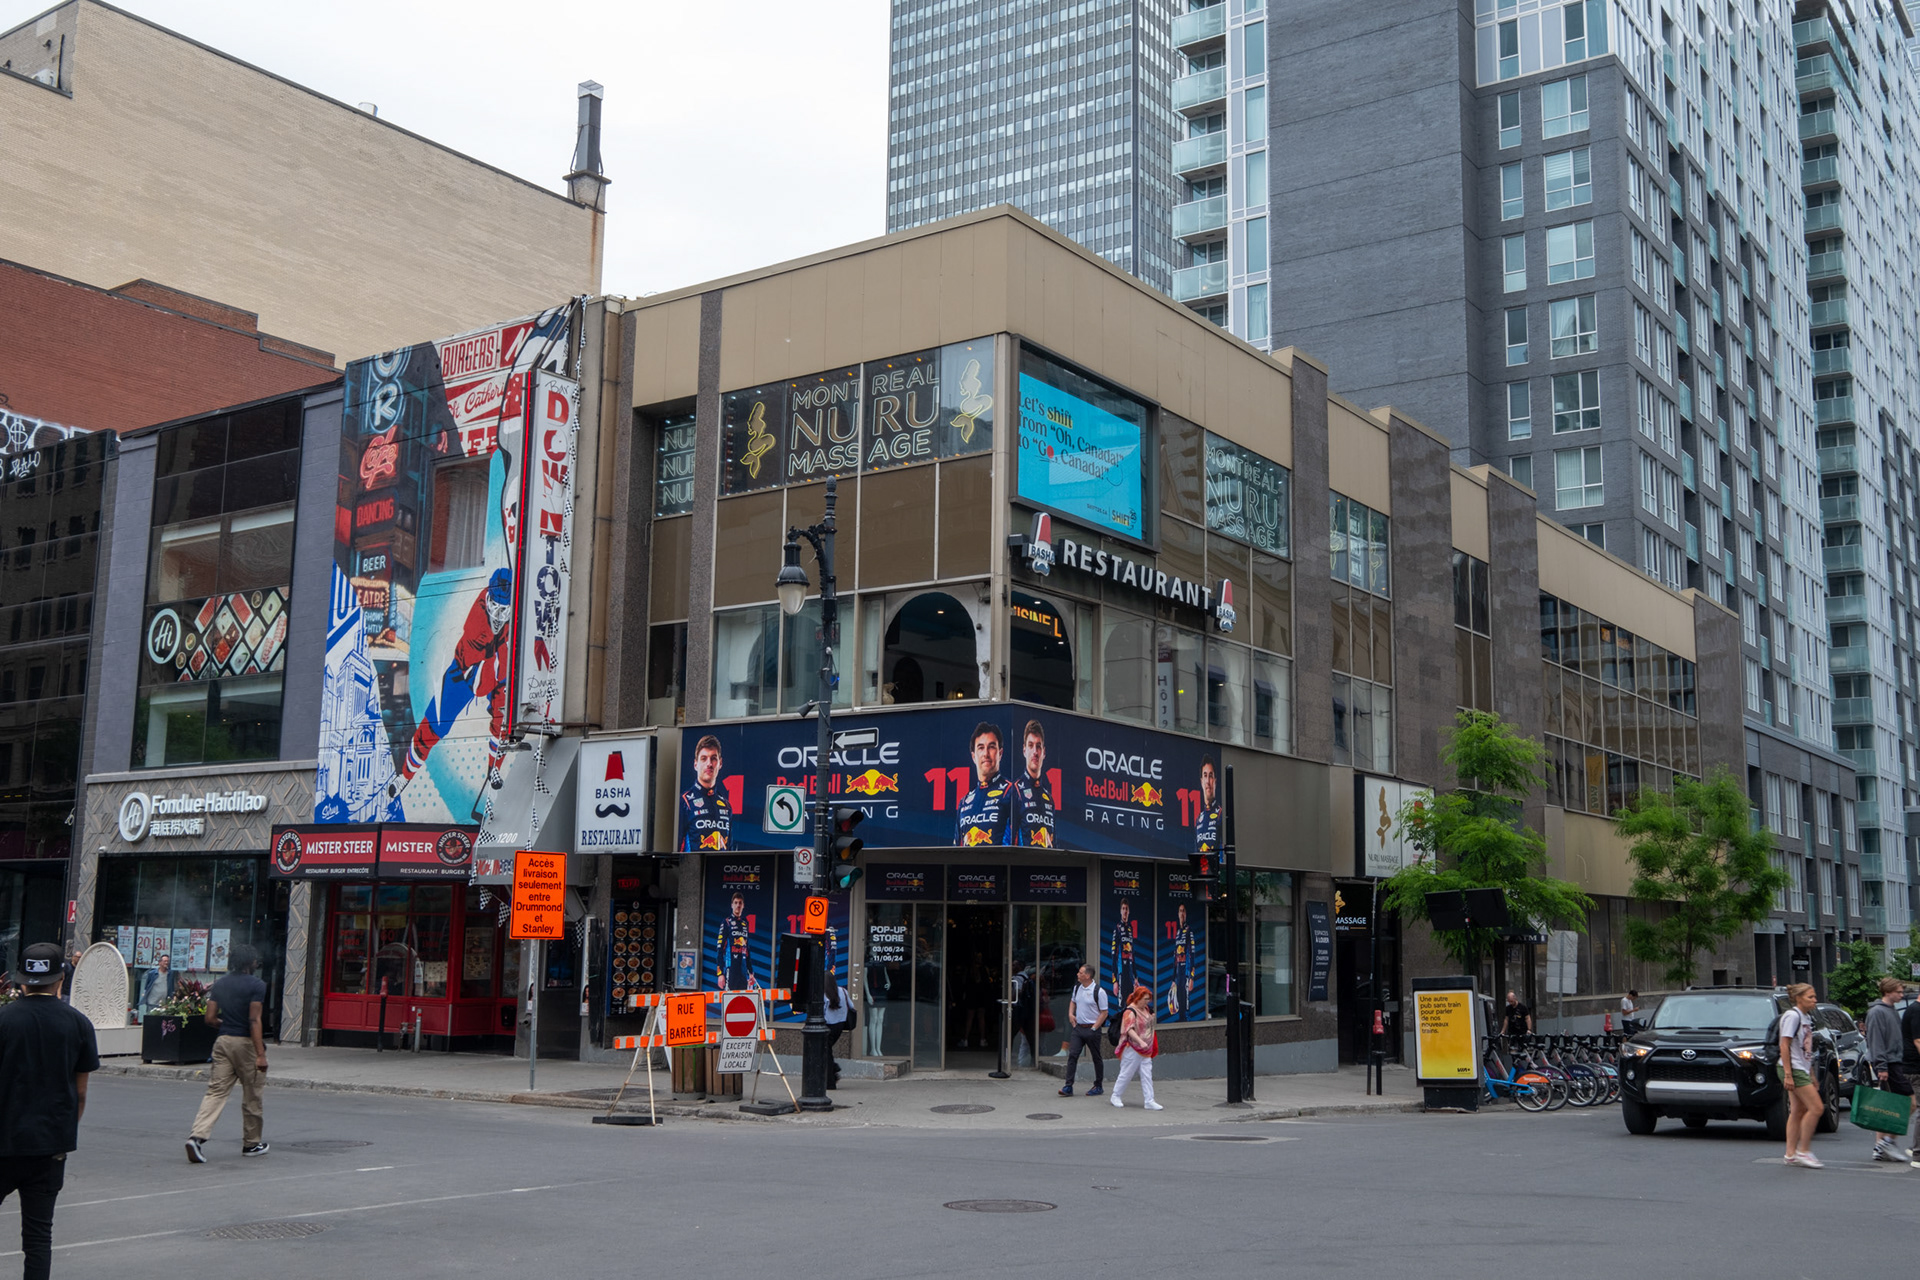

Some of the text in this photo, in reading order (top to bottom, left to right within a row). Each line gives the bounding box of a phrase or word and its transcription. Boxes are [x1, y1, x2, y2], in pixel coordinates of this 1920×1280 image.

[442, 335, 495, 377] BURGERS
[1047, 406, 1073, 428] shift
[1020, 411, 1048, 437] rom
[356, 498, 395, 528] DANCING
[1030, 544, 1056, 562] BASHA
[362, 555, 387, 573] BEER
[1063, 538, 1212, 610] RESTAURANT
[777, 742, 900, 768] ORACLE
[1085, 746, 1163, 780] ORACLE
[595, 787, 631, 799] BASHA
[923, 767, 970, 811] 11
[151, 793, 204, 815] Fondue
[695, 819, 730, 831] ORACLE
[1085, 808, 1165, 831] RACING
[497, 832, 518, 844] 1200
[581, 828, 642, 846] RESTAURANT
[306, 840, 374, 855] MISTER STEER
[386, 841, 433, 853] MISTER
[528, 858, 555, 868] Accès
[723, 865, 760, 873] ORACLE
[400, 867, 438, 875] RESTAURANT
[523, 869, 558, 879] livraison
[1113, 869, 1139, 879] ORACLE
[518, 881, 562, 890] seulement
[528, 892, 551, 901] entre
[516, 902, 562, 912] Drummond
[534, 914, 543, 923] et
[522, 925, 555, 935] Stanley
[870, 925, 907, 934] POP-UP
[873, 934, 904, 942] STORE
[677, 1003, 694, 1015] RUE
[669, 1024, 703, 1040] BARRÉE
[726, 1041, 752, 1050] EXCEPTÉ
[722, 1051, 753, 1059] LIVRAISON
[724, 1060, 747, 1069] LOCALE
